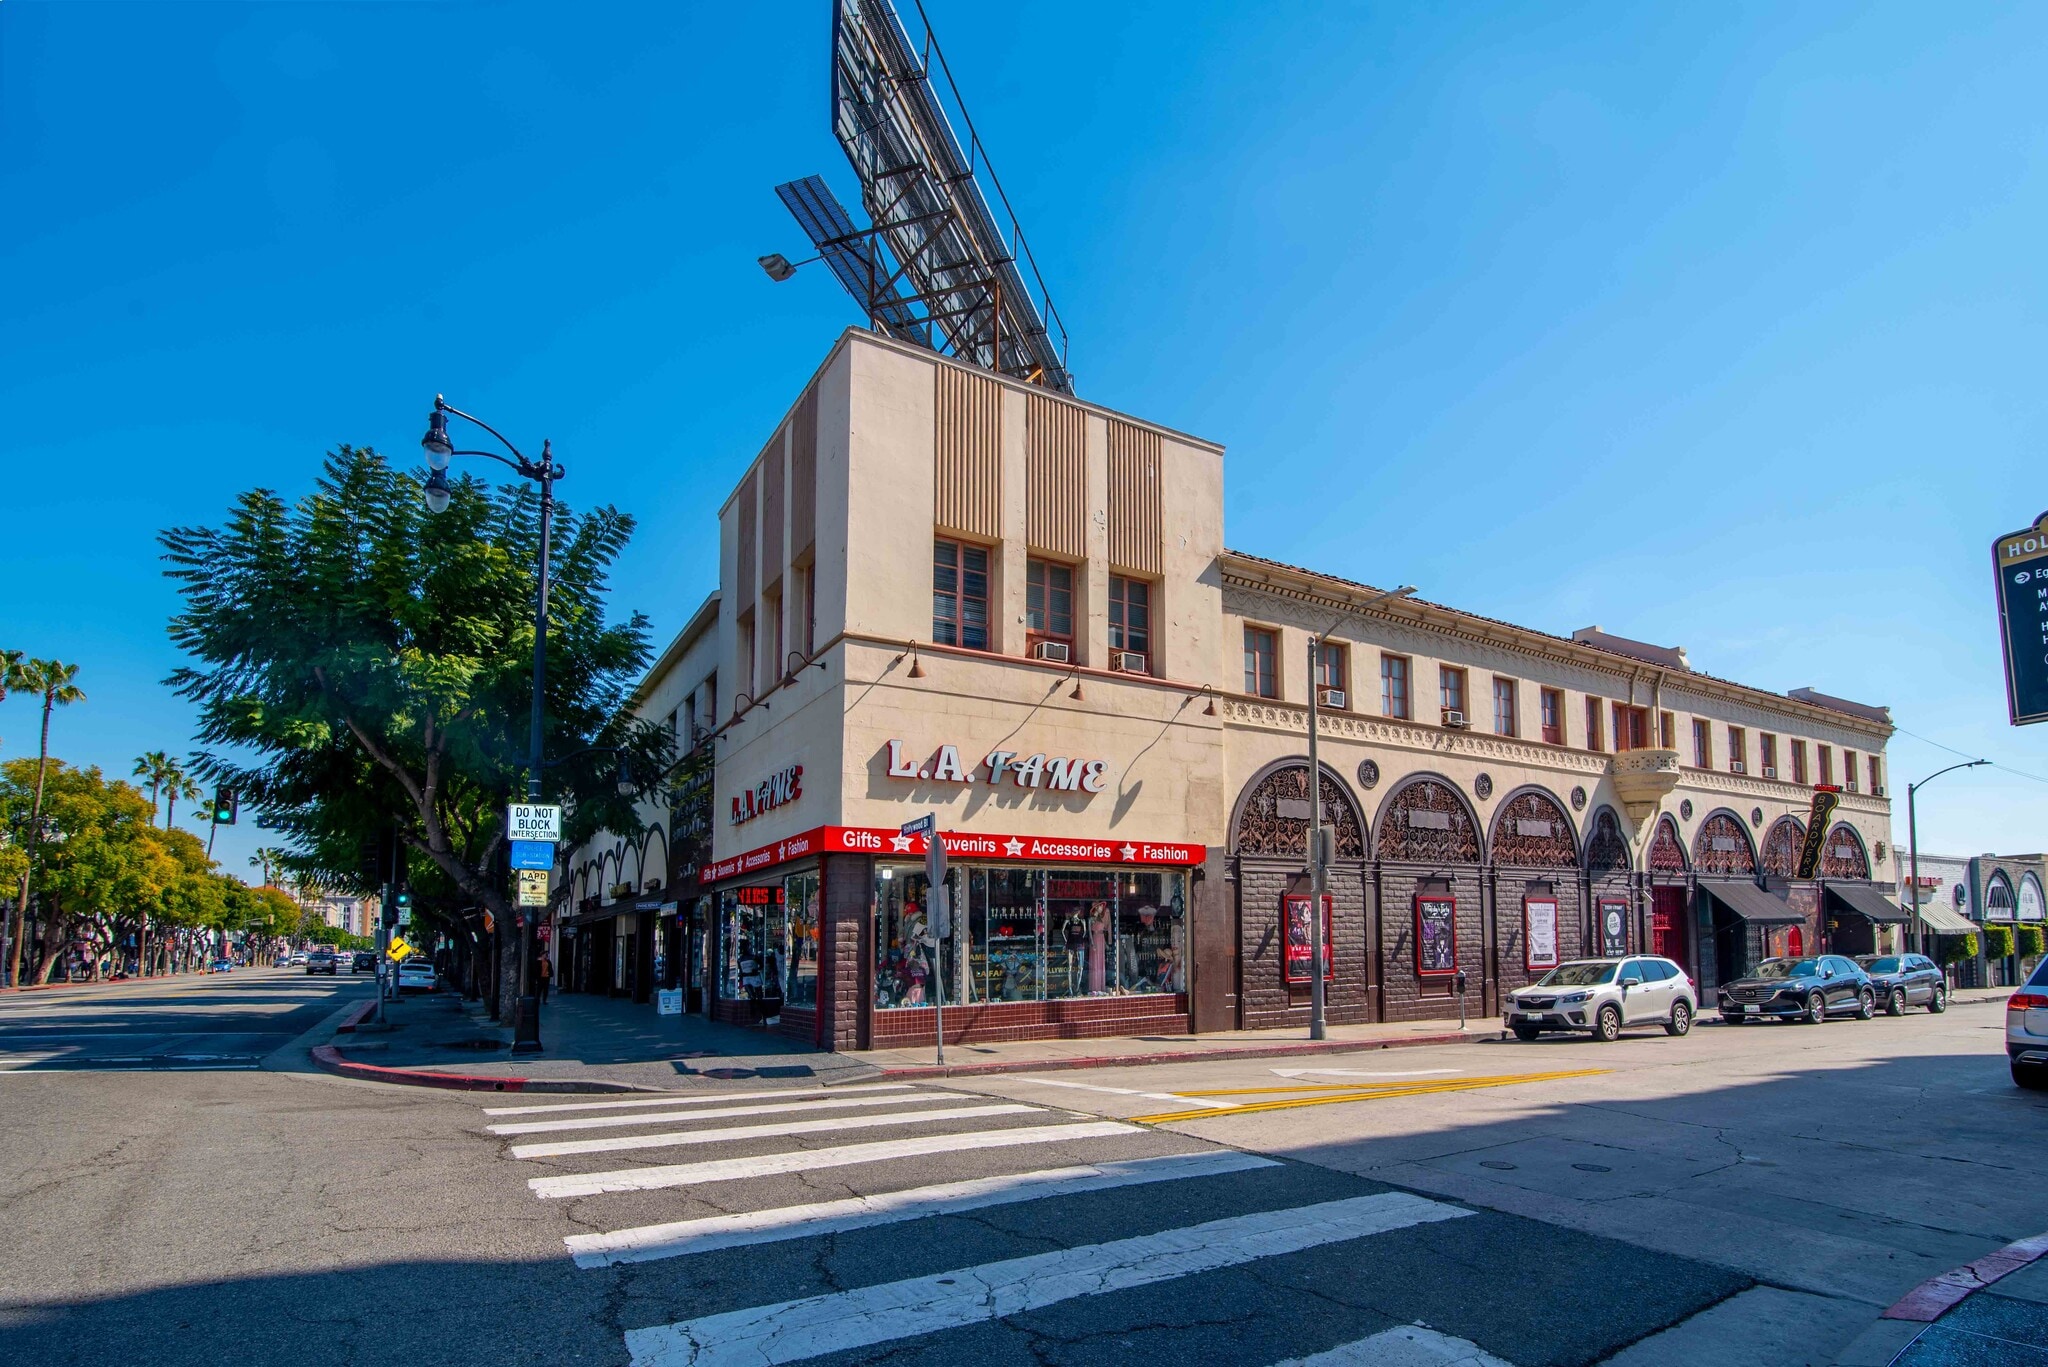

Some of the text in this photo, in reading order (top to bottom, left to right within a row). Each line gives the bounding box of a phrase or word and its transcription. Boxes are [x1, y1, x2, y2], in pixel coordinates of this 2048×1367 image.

[2008, 538, 2048, 558] HOL
[887, 739, 1108, 794] L.A. FAME
[753, 765, 803, 815] FAME
[516, 807, 553, 819] DO NOT
[511, 829, 558, 838] INTERSECTION
[518, 820, 551, 830] BLOCK
[842, 831, 1188, 860] Gifts Suvenirs Accessories Fashion
[717, 861, 735, 877] Souvenirs
[745, 849, 771, 868] Accessories
[787, 838, 809, 856] Fashion
[521, 872, 547, 880] LAPD
